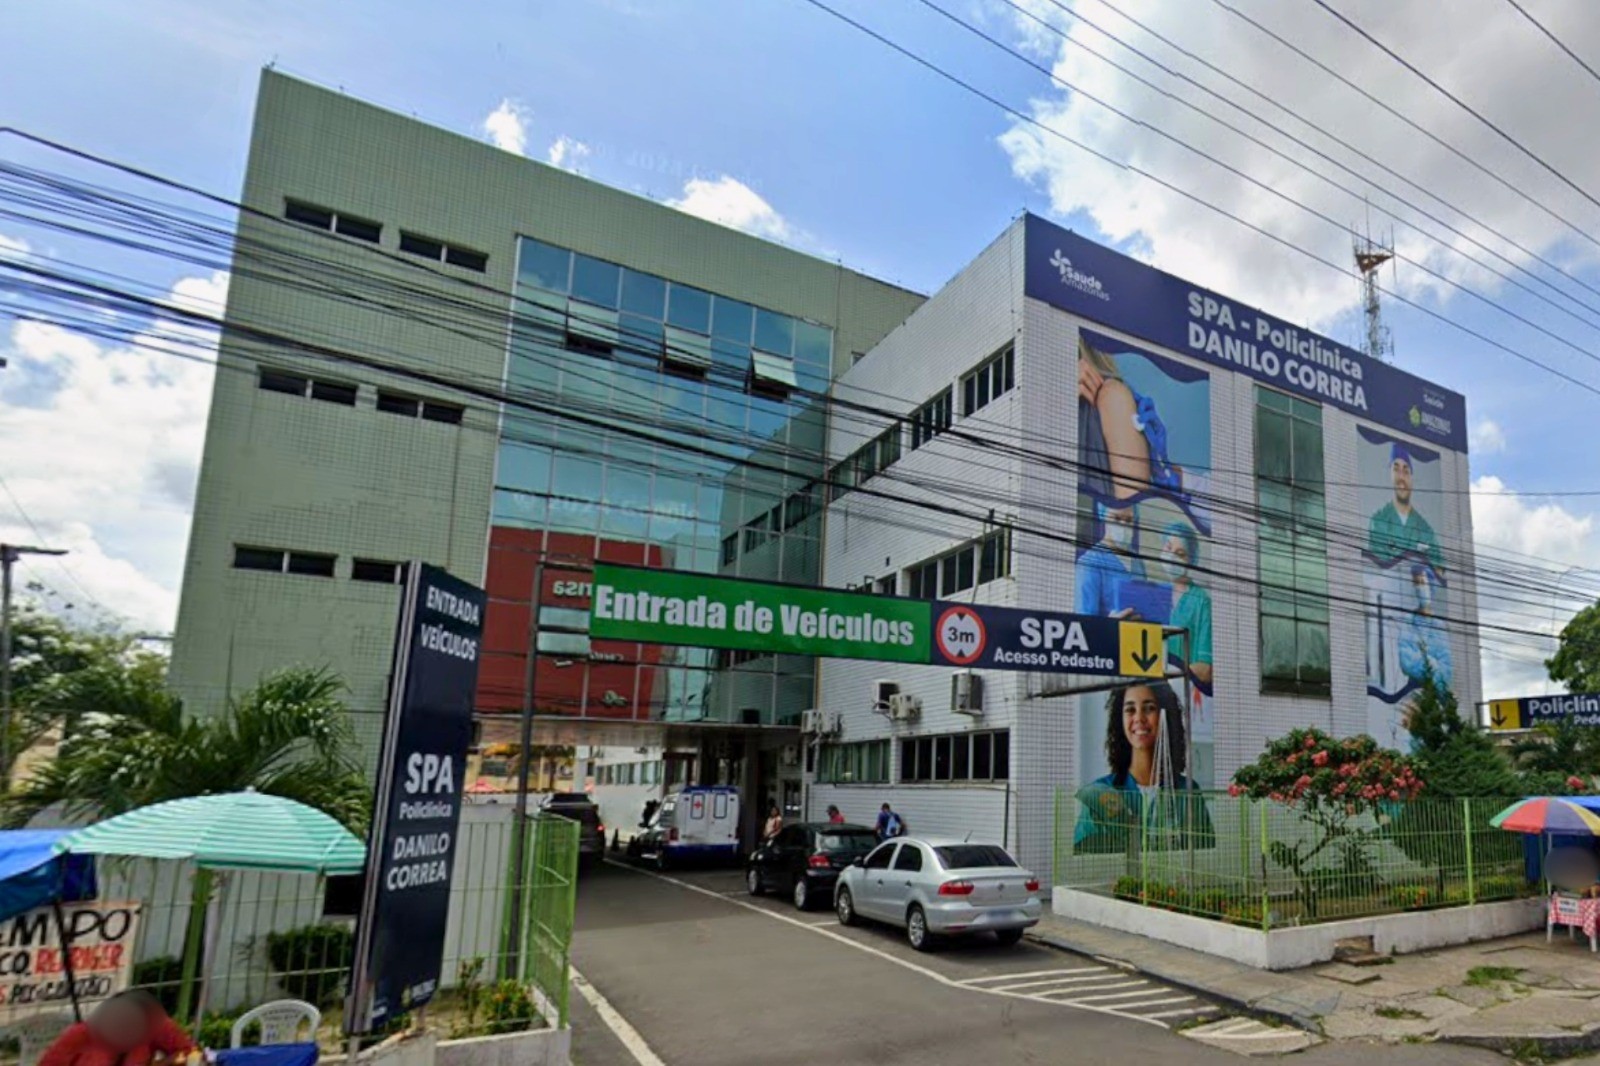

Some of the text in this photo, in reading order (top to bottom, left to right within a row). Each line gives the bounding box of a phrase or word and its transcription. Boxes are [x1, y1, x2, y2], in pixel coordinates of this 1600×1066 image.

[1188, 291, 1362, 380] SPA - Policlínica
[1189, 321, 1367, 410] DANILO CORREA
[426, 584, 480, 626] ENTRADA
[595, 584, 727, 630] Entrada
[734, 600, 774, 633] de
[421, 622, 477, 661] VEÍCULOS
[948, 626, 975, 644] 3m
[1020, 617, 1089, 651] SPA
[994, 648, 1115, 670] Acesso Pedestre
[1528, 695, 1600, 716] Policlín
[404, 752, 454, 794] SPA
[399, 801, 453, 819] Policlínica
[393, 832, 450, 860] DANILO
[386, 860, 446, 891] CORREA
